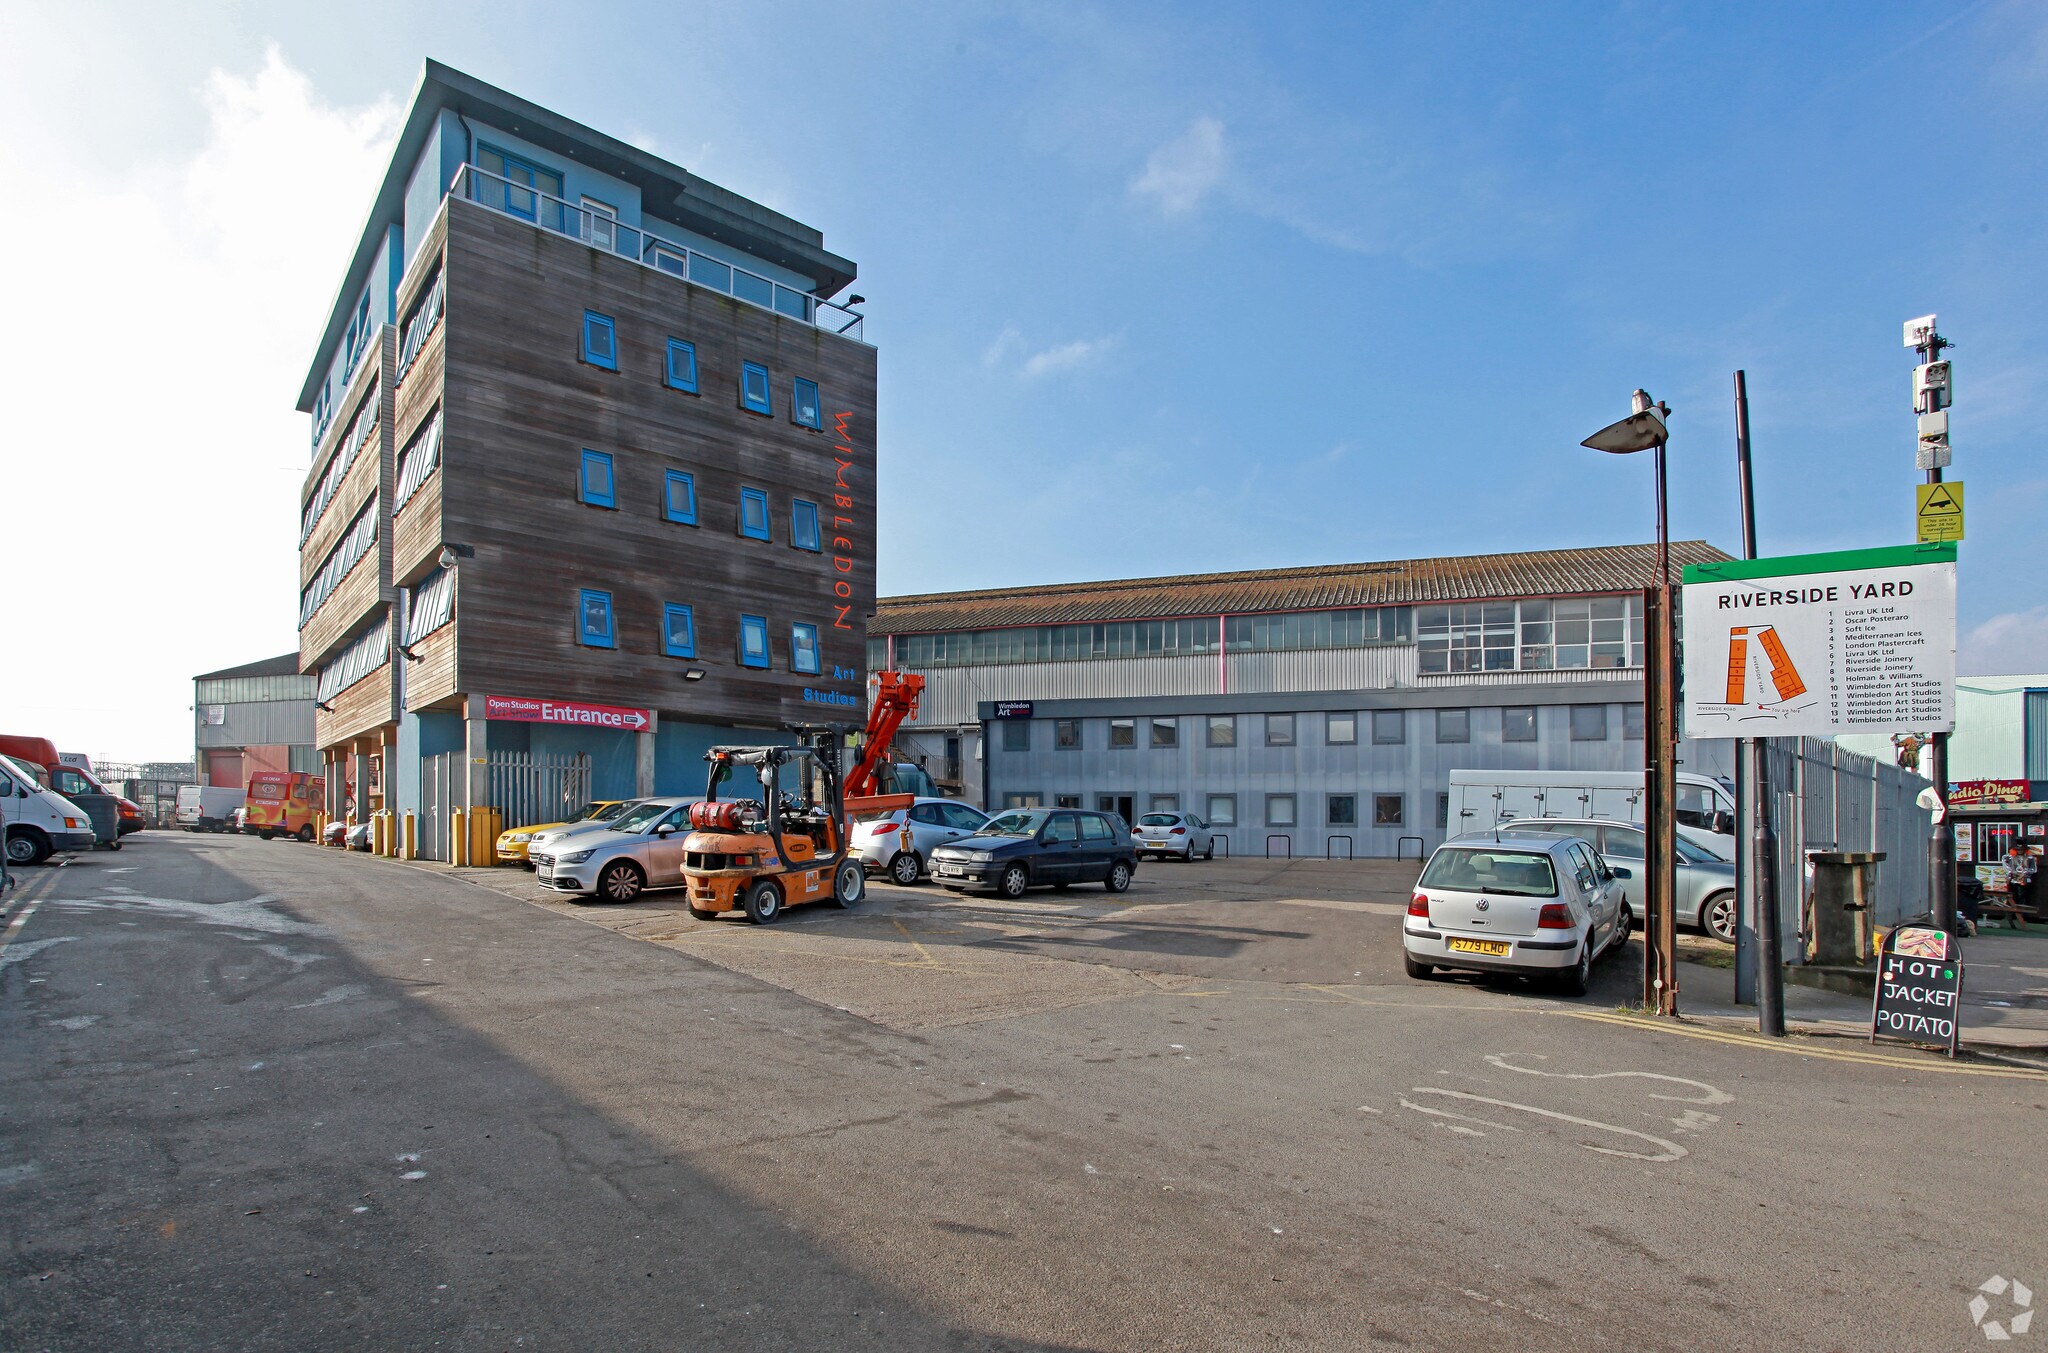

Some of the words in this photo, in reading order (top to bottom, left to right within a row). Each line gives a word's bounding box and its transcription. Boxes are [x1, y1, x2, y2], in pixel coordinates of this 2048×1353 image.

[834, 412, 852, 629] WIMBLEDON
[1718, 587, 1838, 609] RIVERSIDE
[1849, 581, 1914, 599] YARD
[1870, 615, 1908, 623] Posteraro
[1845, 632, 1903, 641] Mediterranean
[1846, 641, 1875, 649] London
[1878, 639, 1925, 647] Plastercraft
[833, 665, 855, 680] Art
[1753, 656, 1761, 680] RIVERSIDE
[1846, 665, 1881, 673] Riverside
[489, 700, 510, 709] Open
[511, 701, 539, 710] Studios
[803, 688, 856, 706] Studios
[489, 709, 506, 717] Art
[510, 709, 538, 719] Show
[542, 703, 621, 725] Entrance
[1949, 787, 1981, 799] udio
[1983, 782, 2023, 796] Diner
[1456, 939, 1480, 950] S779
[1484, 943, 1504, 953] LMO
[1889, 959, 1941, 978] HOT
[1884, 983, 1955, 1007] JACKET
[1877, 1010, 1952, 1037] POTATO
